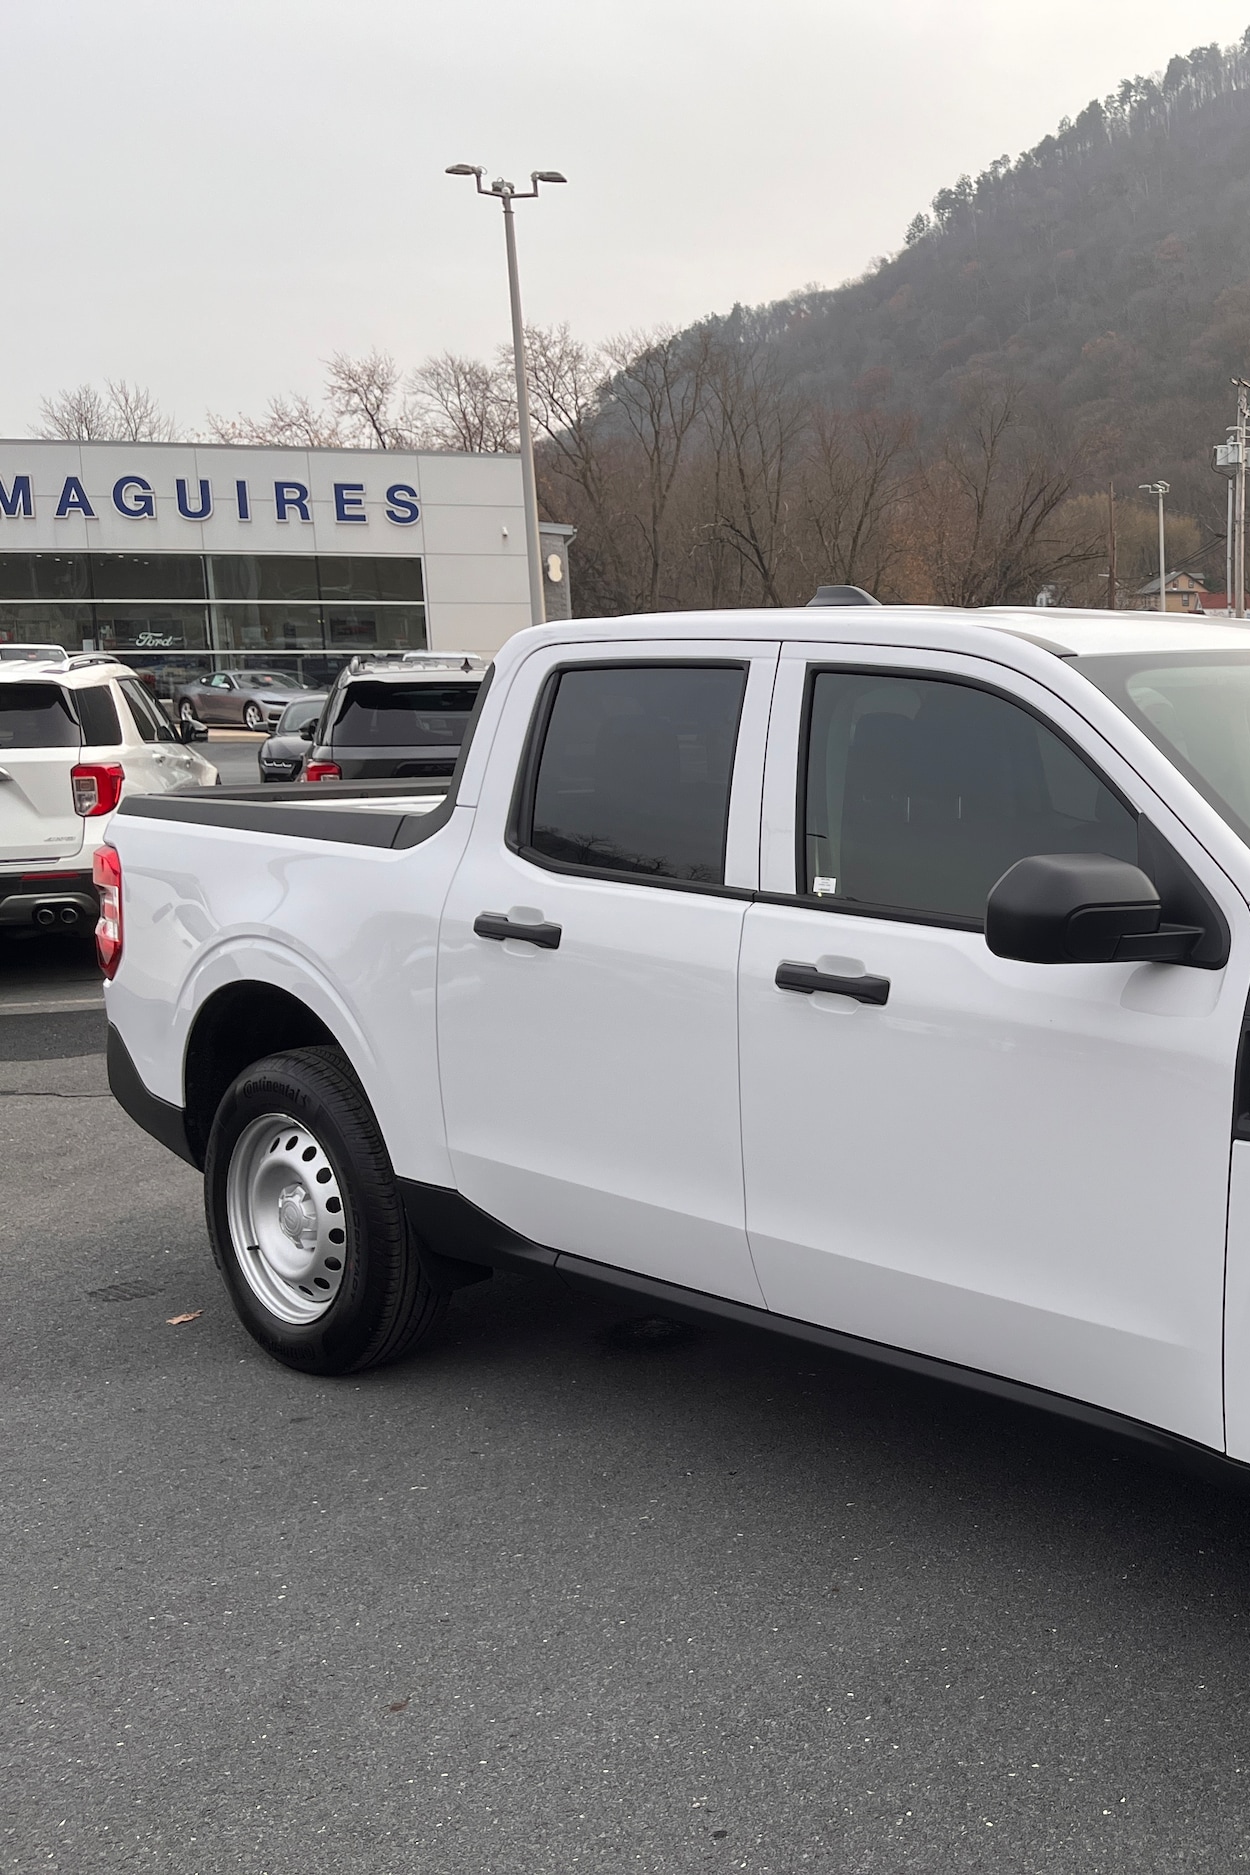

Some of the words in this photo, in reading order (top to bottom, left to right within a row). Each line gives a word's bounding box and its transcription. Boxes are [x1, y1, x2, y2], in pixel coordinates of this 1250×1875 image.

[0, 474, 422, 526] MAGUIRES
[135, 631, 174, 647] Ford
[243, 1075, 301, 1104] Continental
